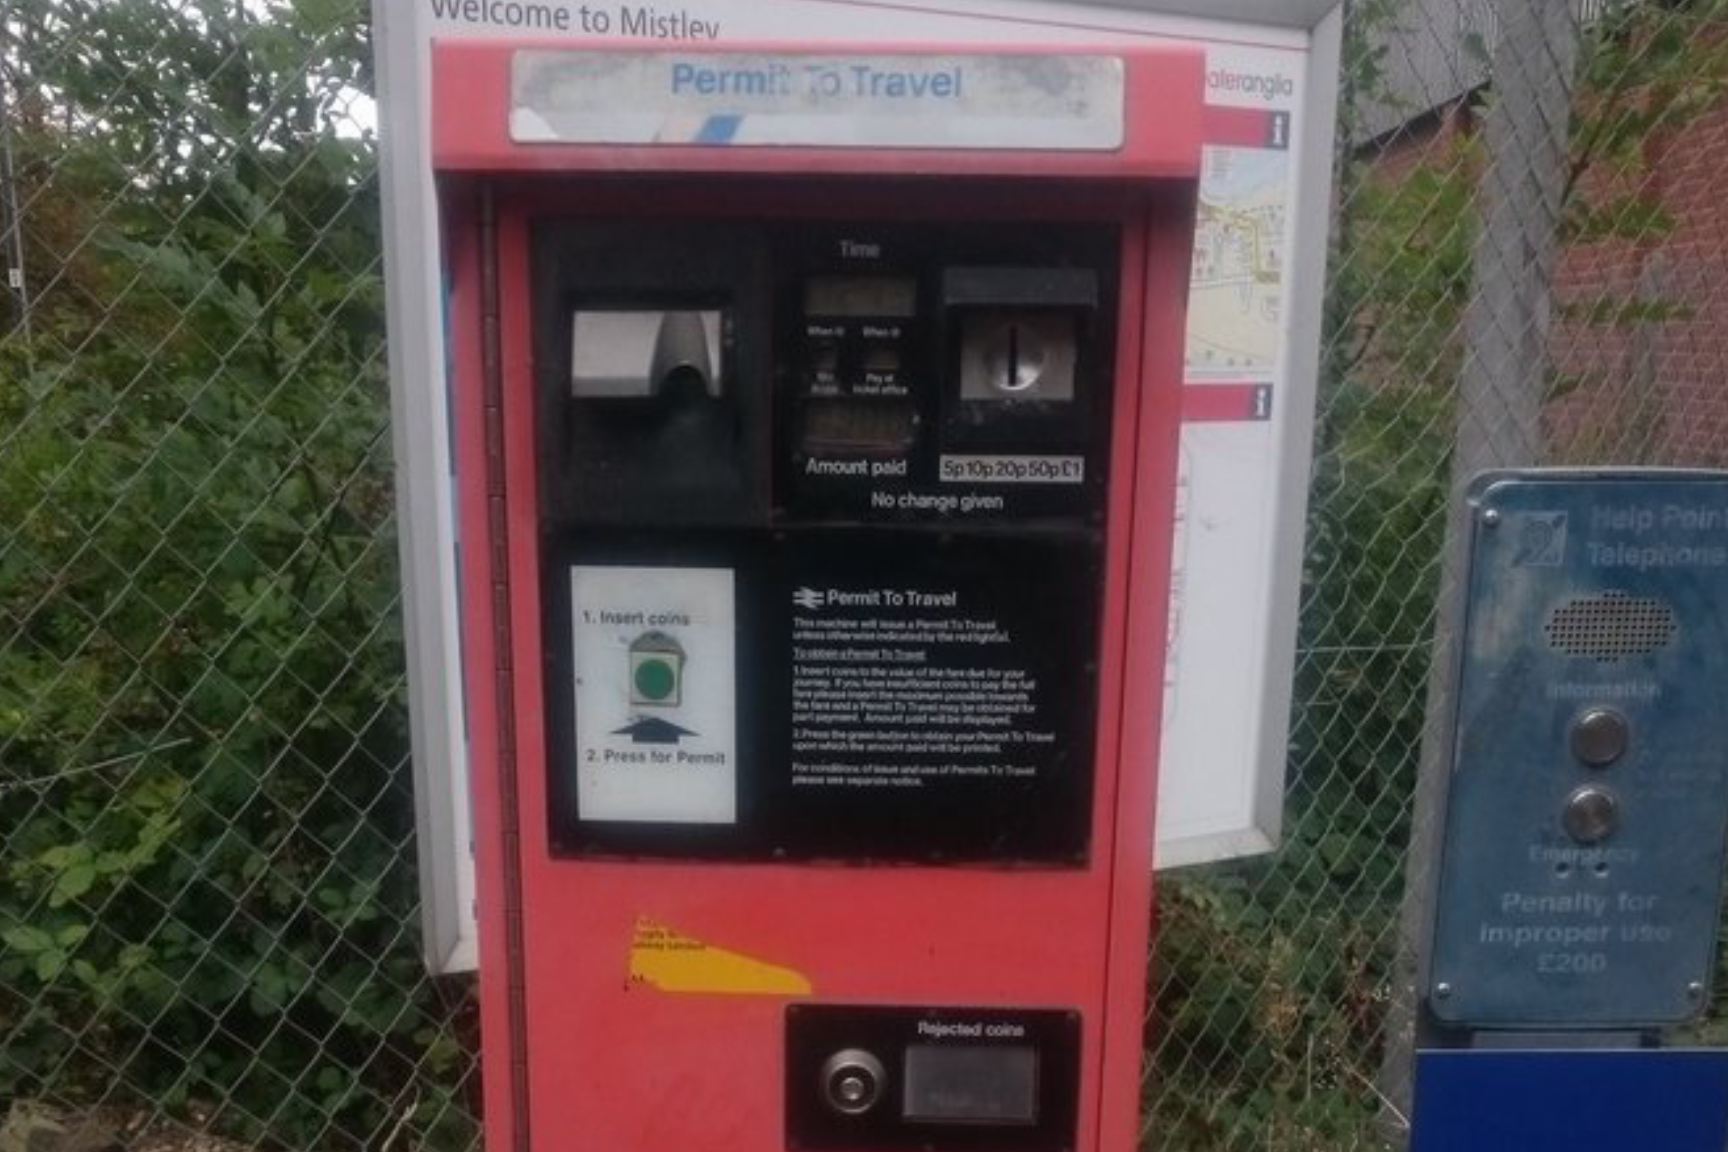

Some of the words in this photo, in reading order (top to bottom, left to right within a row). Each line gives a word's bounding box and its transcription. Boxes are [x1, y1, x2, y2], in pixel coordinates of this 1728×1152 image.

[430, 0, 571, 31] Welcome
[578, 6, 611, 34] to
[620, 6, 721, 40] Mistley
[671, 63, 792, 95] Permit
[803, 64, 843, 98] To
[850, 64, 963, 98] Travel
[1205, 69, 1294, 101] ateranglia
[839, 240, 880, 259] Time
[805, 457, 868, 476] Amount
[871, 459, 907, 478] paid
[944, 459, 965, 478] 5p
[966, 460, 994, 480] 10p
[995, 460, 1027, 480] 20p
[1028, 460, 1060, 481] 50p
[871, 490, 895, 508] No
[897, 491, 957, 513] change
[959, 493, 1004, 512] given
[1591, 503, 1653, 536] Help
[1587, 541, 1726, 572] Telephone
[827, 588, 880, 606] Permit
[882, 588, 904, 607] To
[905, 589, 957, 607] Travel
[583, 610, 596, 625] 1.
[600, 609, 644, 625] Insert
[647, 610, 690, 626] coins
[916, 618, 949, 632] Permit
[950, 619, 965, 632] To
[966, 619, 997, 632] Travel
[586, 749, 601, 762] 2.
[604, 749, 646, 763] Press
[650, 750, 672, 763] for
[677, 750, 725, 765] Permit
[1502, 891, 1609, 917] Penalty
[1617, 891, 1660, 912] for
[1536, 952, 1608, 974] £200
[917, 1020, 982, 1038] Rejected
[984, 1023, 1025, 1037] coins
